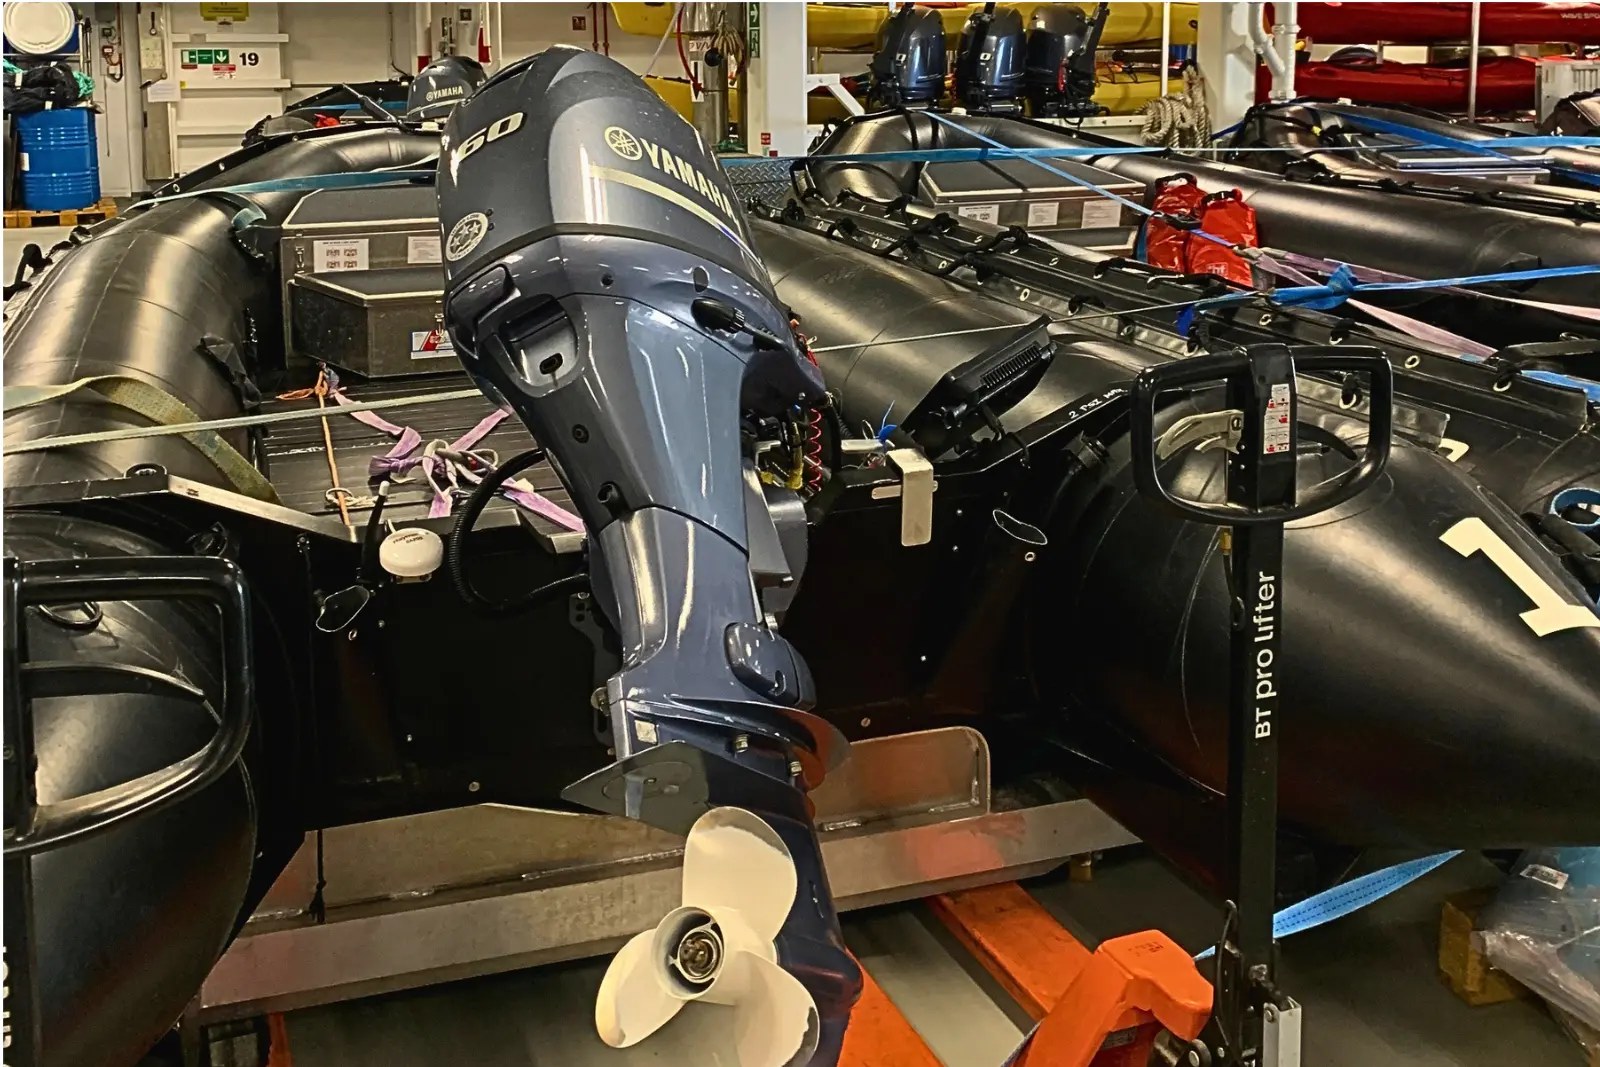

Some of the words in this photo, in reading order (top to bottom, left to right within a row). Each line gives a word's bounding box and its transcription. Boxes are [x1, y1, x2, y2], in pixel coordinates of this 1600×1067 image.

[239, 52, 259, 67] 19
[433, 85, 464, 99] YAMAHA
[457, 111, 524, 163] 60
[640, 137, 740, 226] YAMAHA
[1068, 410, 1080, 420] 2
[1438, 516, 1600, 638] 1
[1252, 571, 1276, 643] lifter
[1256, 648, 1278, 700] pro
[1255, 707, 1272, 739] BT
